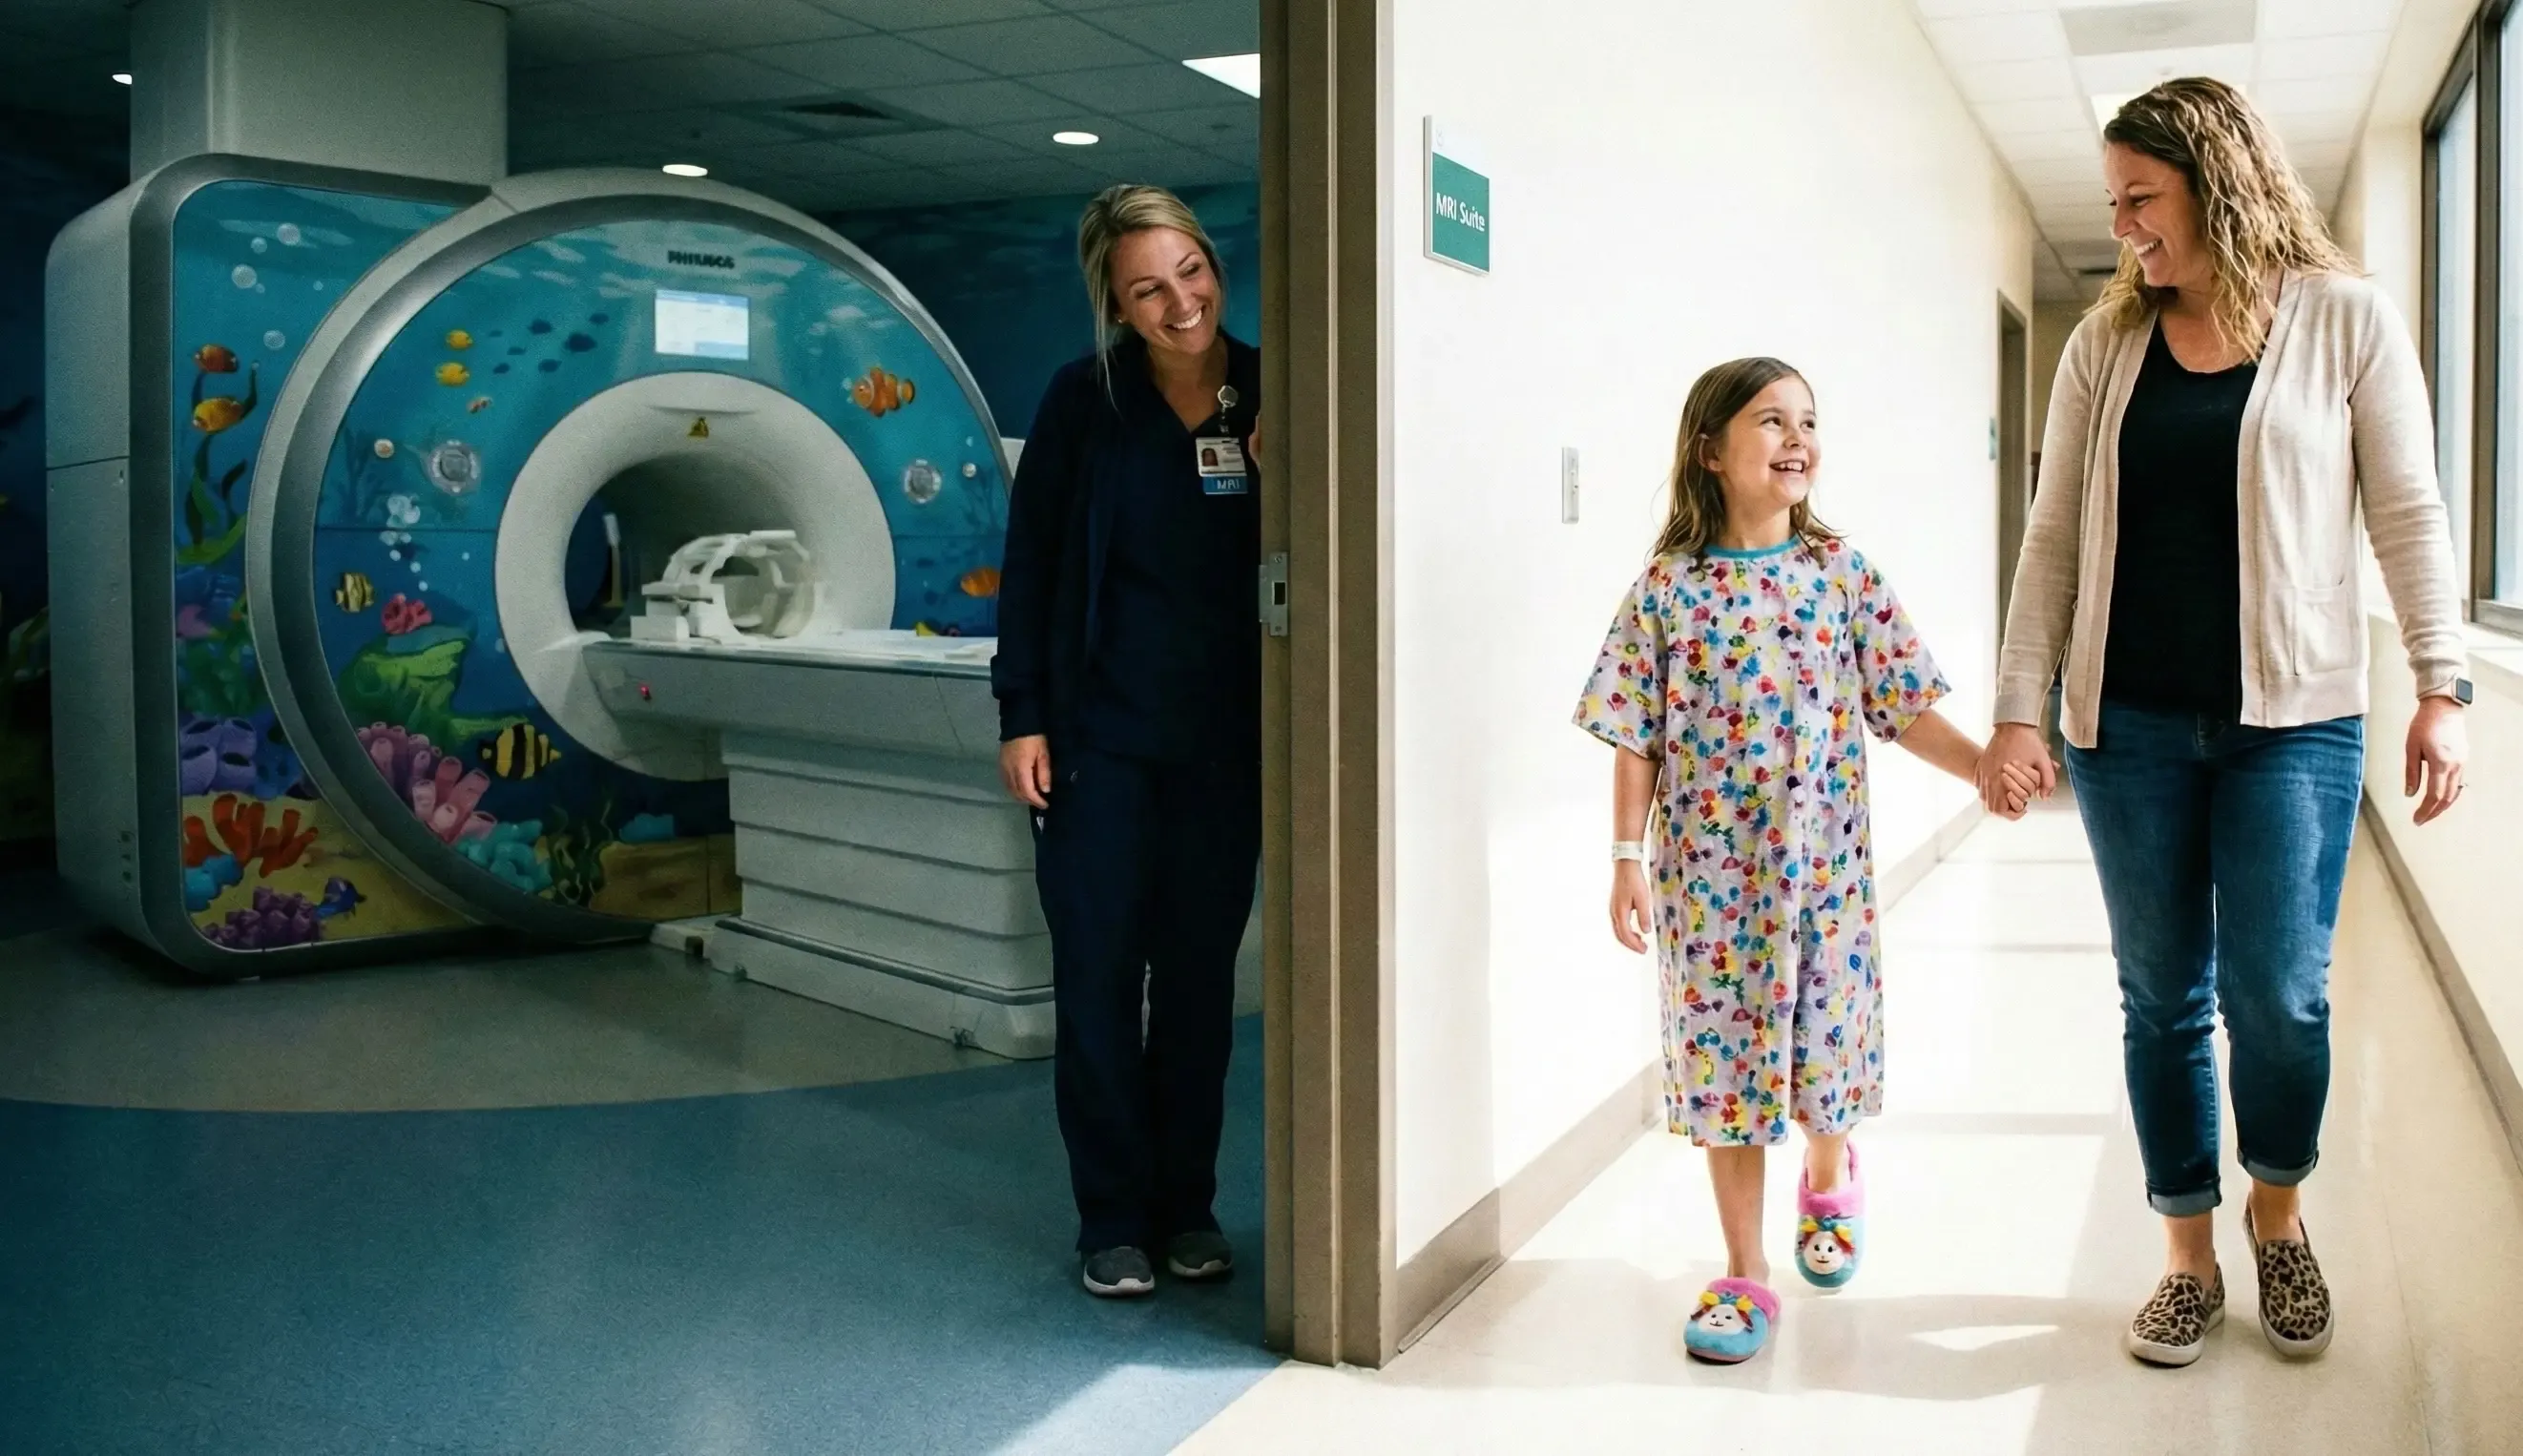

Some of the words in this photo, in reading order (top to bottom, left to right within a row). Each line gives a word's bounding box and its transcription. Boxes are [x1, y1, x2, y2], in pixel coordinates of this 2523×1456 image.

[1436, 192, 1457, 221] MRI
[1459, 201, 1486, 233] Suite
[1217, 478, 1240, 489] MRI
